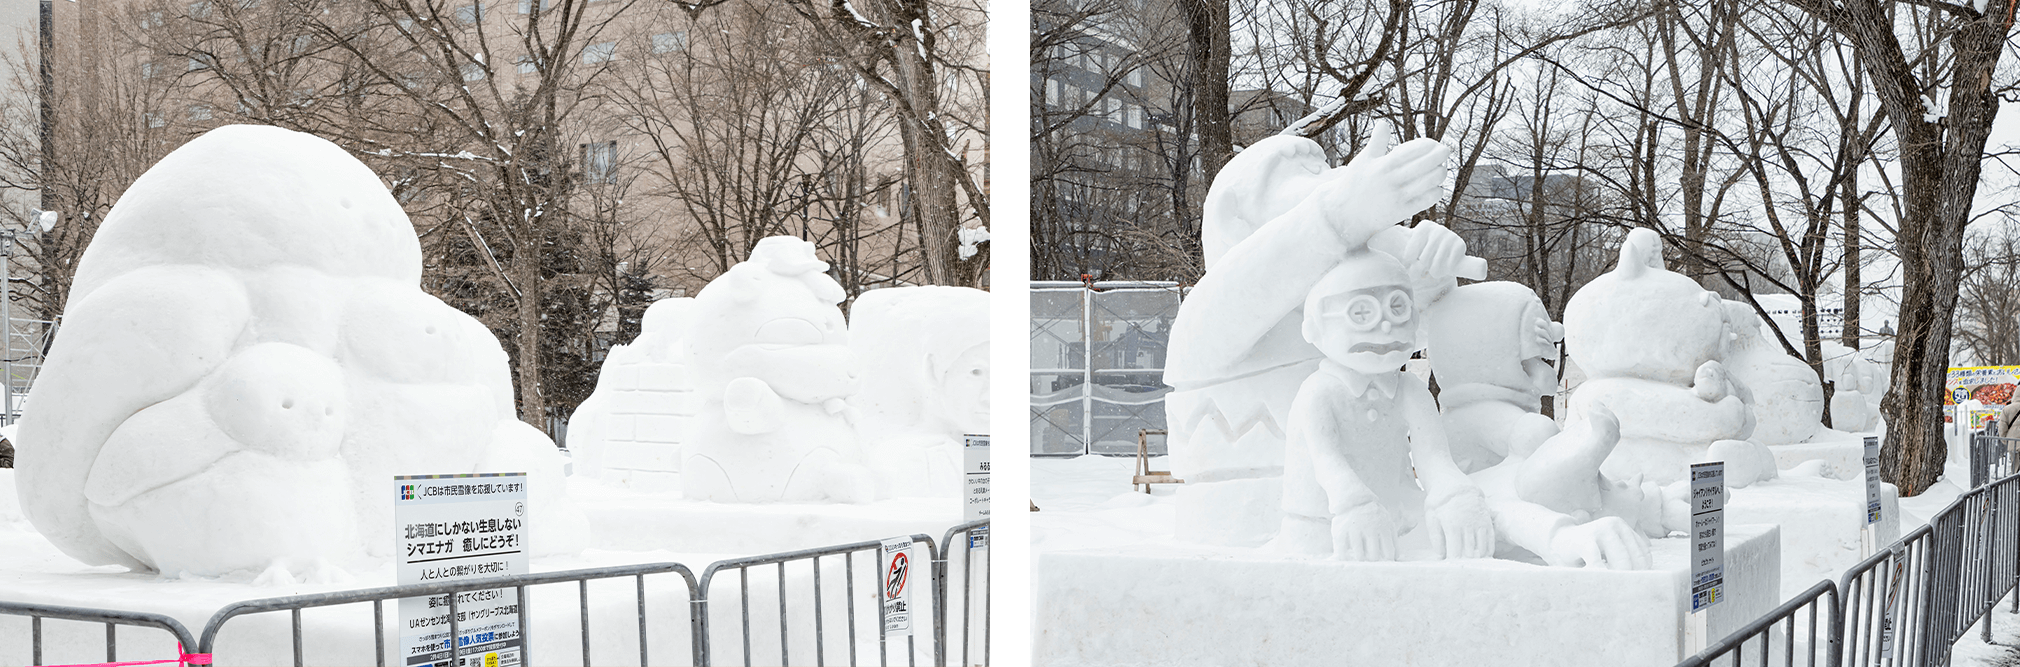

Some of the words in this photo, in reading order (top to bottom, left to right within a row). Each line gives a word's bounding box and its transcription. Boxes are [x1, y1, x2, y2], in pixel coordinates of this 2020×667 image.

[423, 483, 523, 497] JCBは市民雪像を応援しています！
[405, 518, 521, 539] 北海道にしかない生息しない
[407, 539, 454, 557] シマエナガ
[462, 534, 519, 552] 癒しにどうぞ！
[420, 561, 509, 581] 人と人との繋がりを大切に！
[428, 589, 503, 609] 姿に癒れてください！
[411, 630, 520, 654] スマホを使って市雪像人気投票に参加しよう
